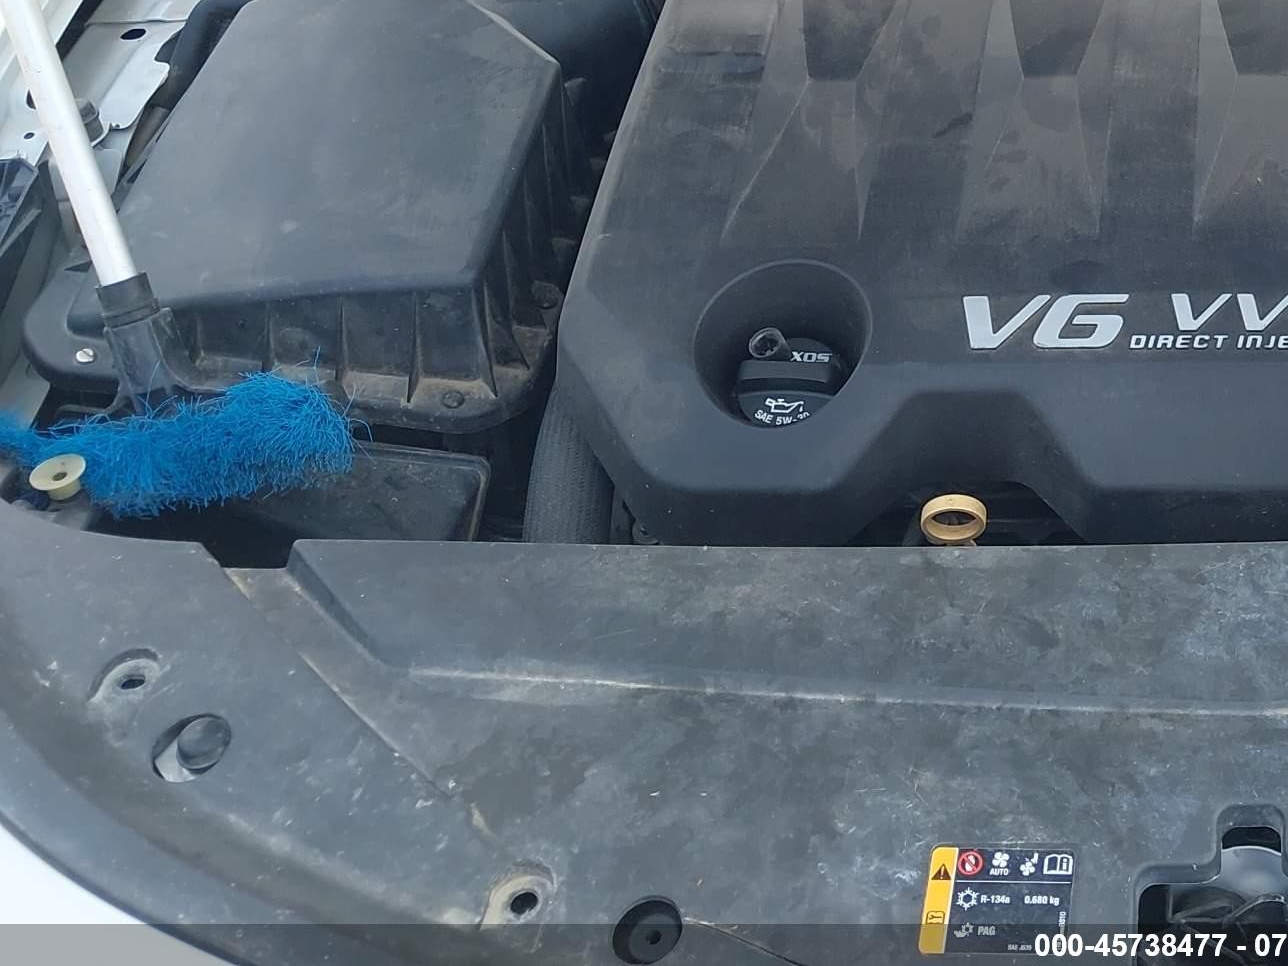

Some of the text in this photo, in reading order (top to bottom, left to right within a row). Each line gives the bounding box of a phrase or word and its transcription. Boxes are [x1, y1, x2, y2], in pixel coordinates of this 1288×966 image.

[961, 292, 1132, 351] V6
[1129, 334, 1230, 350] DIRECT
[754, 409, 774, 424] SAE
[989, 868, 1010, 876] AUTO
[980, 895, 1060, 907] R-134a 0.680 kg
[977, 925, 996, 936] PAG
